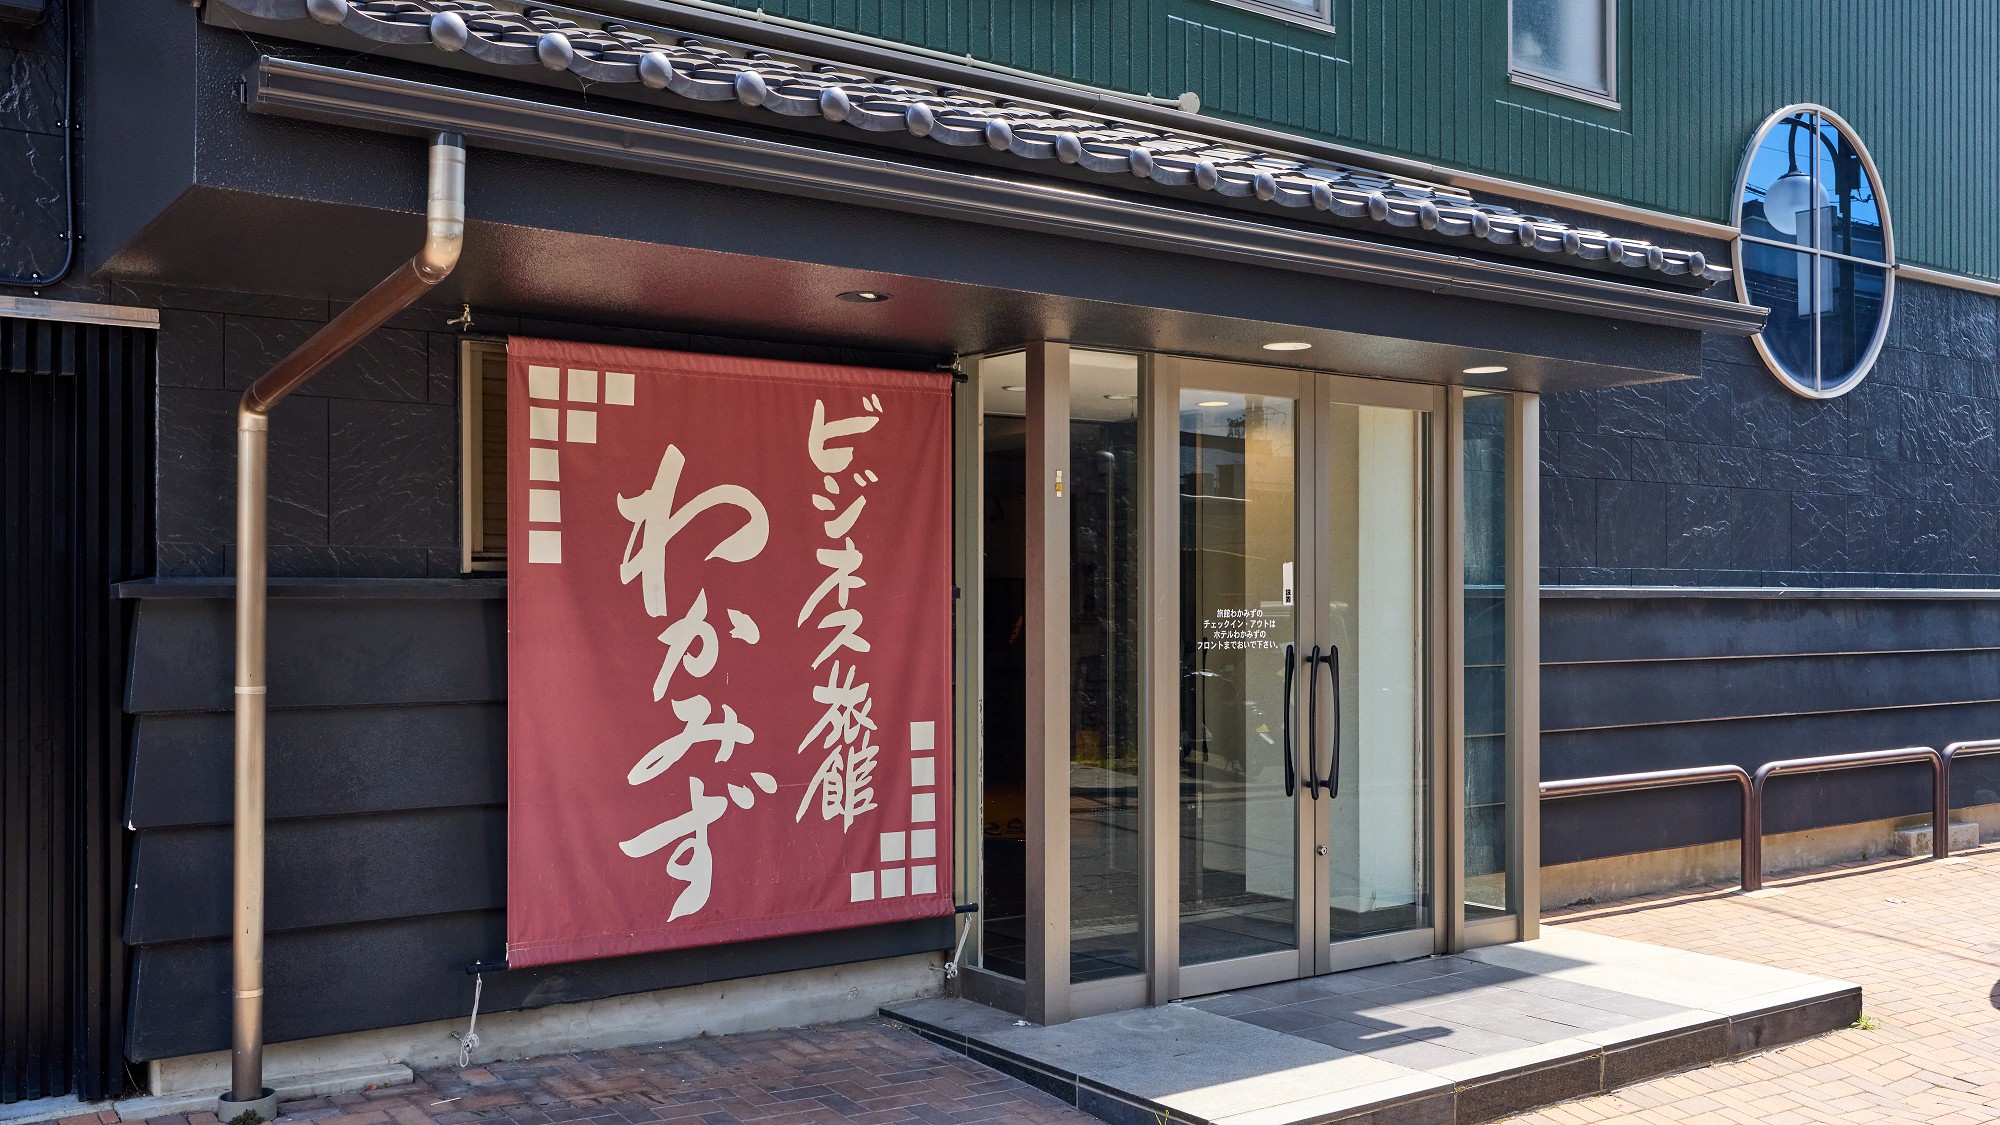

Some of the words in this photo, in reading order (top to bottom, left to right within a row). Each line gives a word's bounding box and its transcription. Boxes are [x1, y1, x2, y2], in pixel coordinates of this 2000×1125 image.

[796, 393, 883, 834] ビジネス旅館
[1216, 608, 1263, 618] 旅館わかみずの
[1203, 619, 1276, 629] チェックイン・アウトは
[1213, 630, 1267, 639] ホテルわかみずの
[1197, 640, 1279, 650] フロントまでおいで下さい。
[617, 444, 777, 922] わかみず
